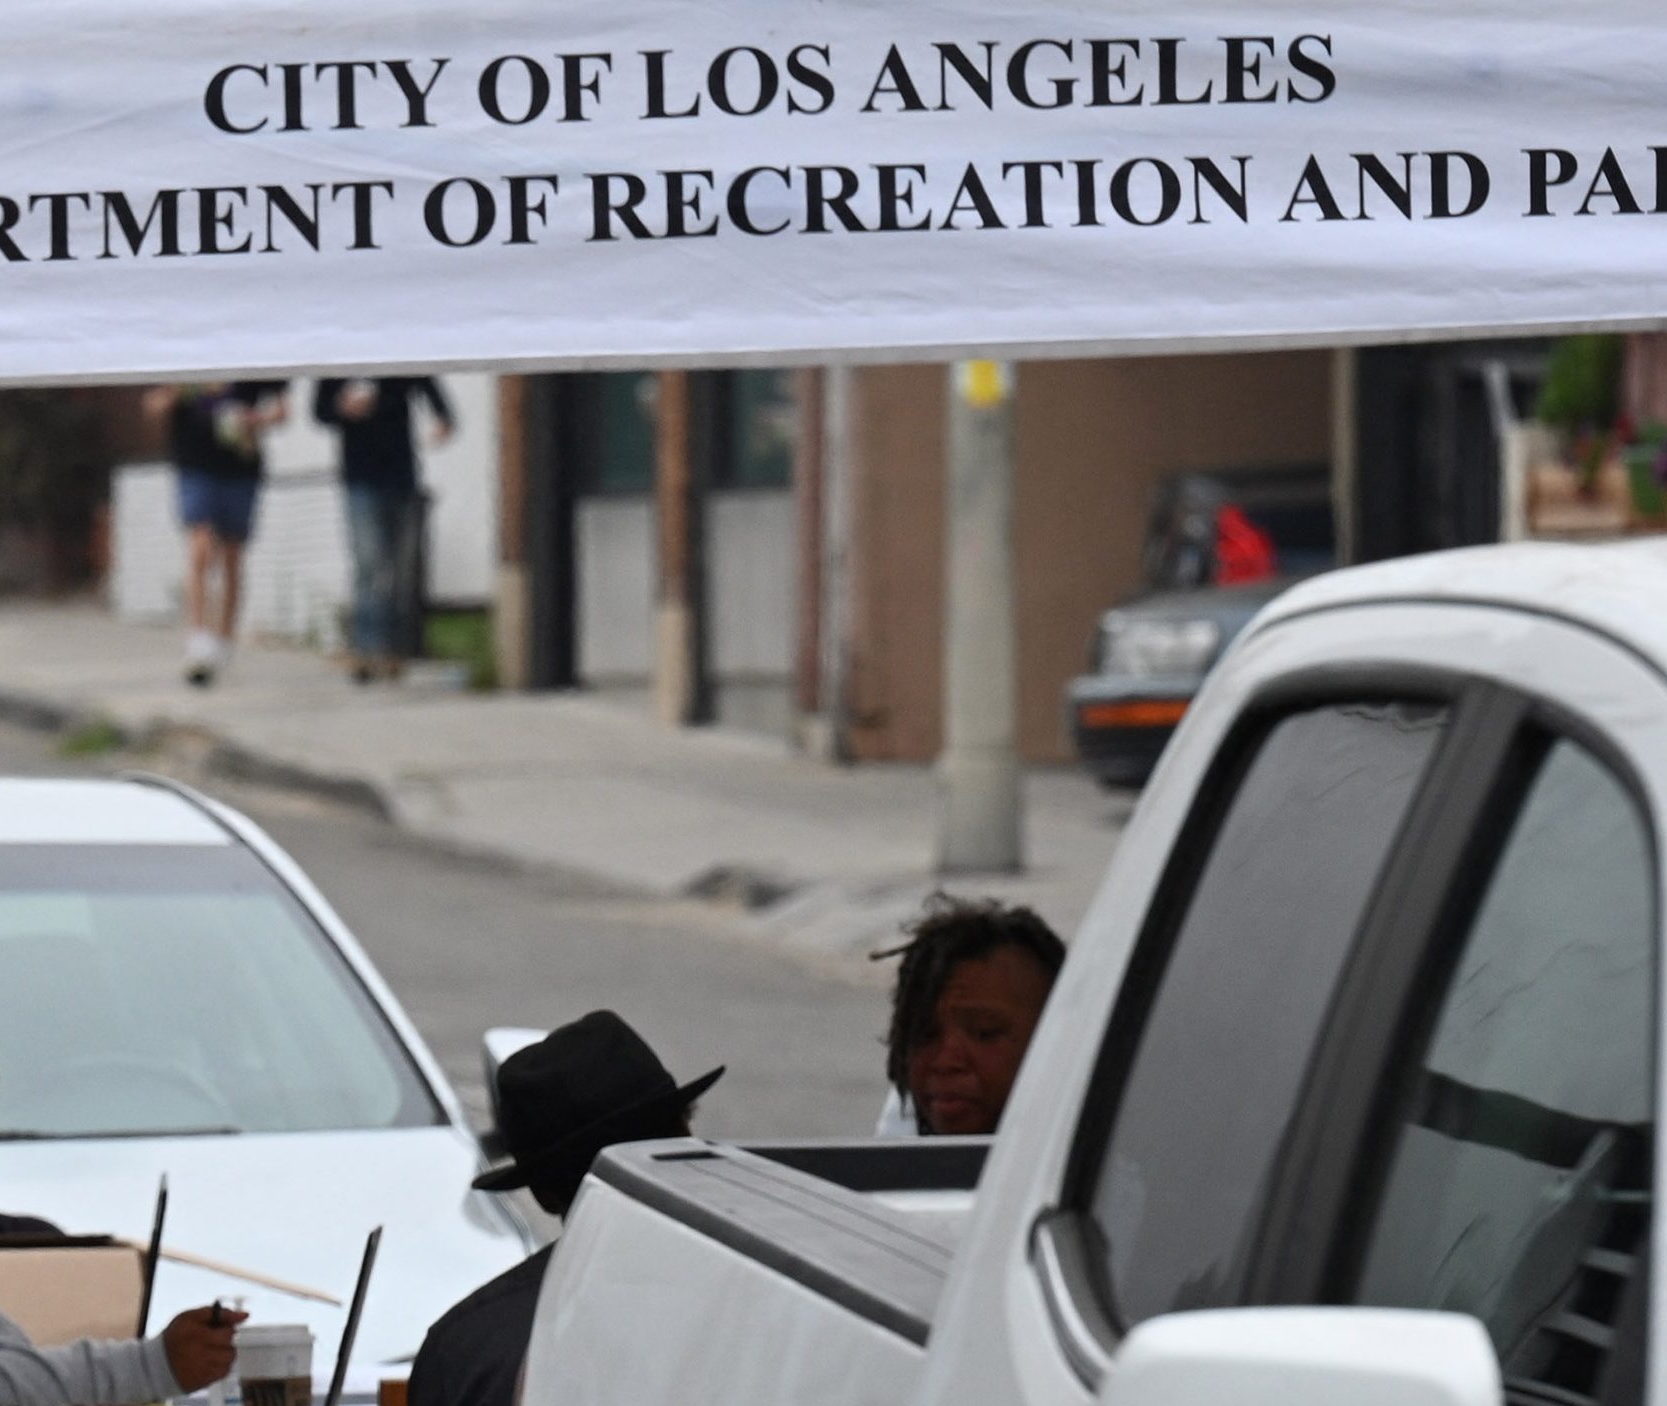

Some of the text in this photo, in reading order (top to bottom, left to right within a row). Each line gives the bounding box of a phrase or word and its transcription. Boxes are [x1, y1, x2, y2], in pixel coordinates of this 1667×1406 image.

[204, 34, 1337, 134] CITY OF LOS ANGELES
[423, 174, 559, 247] OF
[584, 155, 1253, 242] RECREATION
[1279, 151, 1491, 222] AND
[1521, 146, 1667, 217] PA
